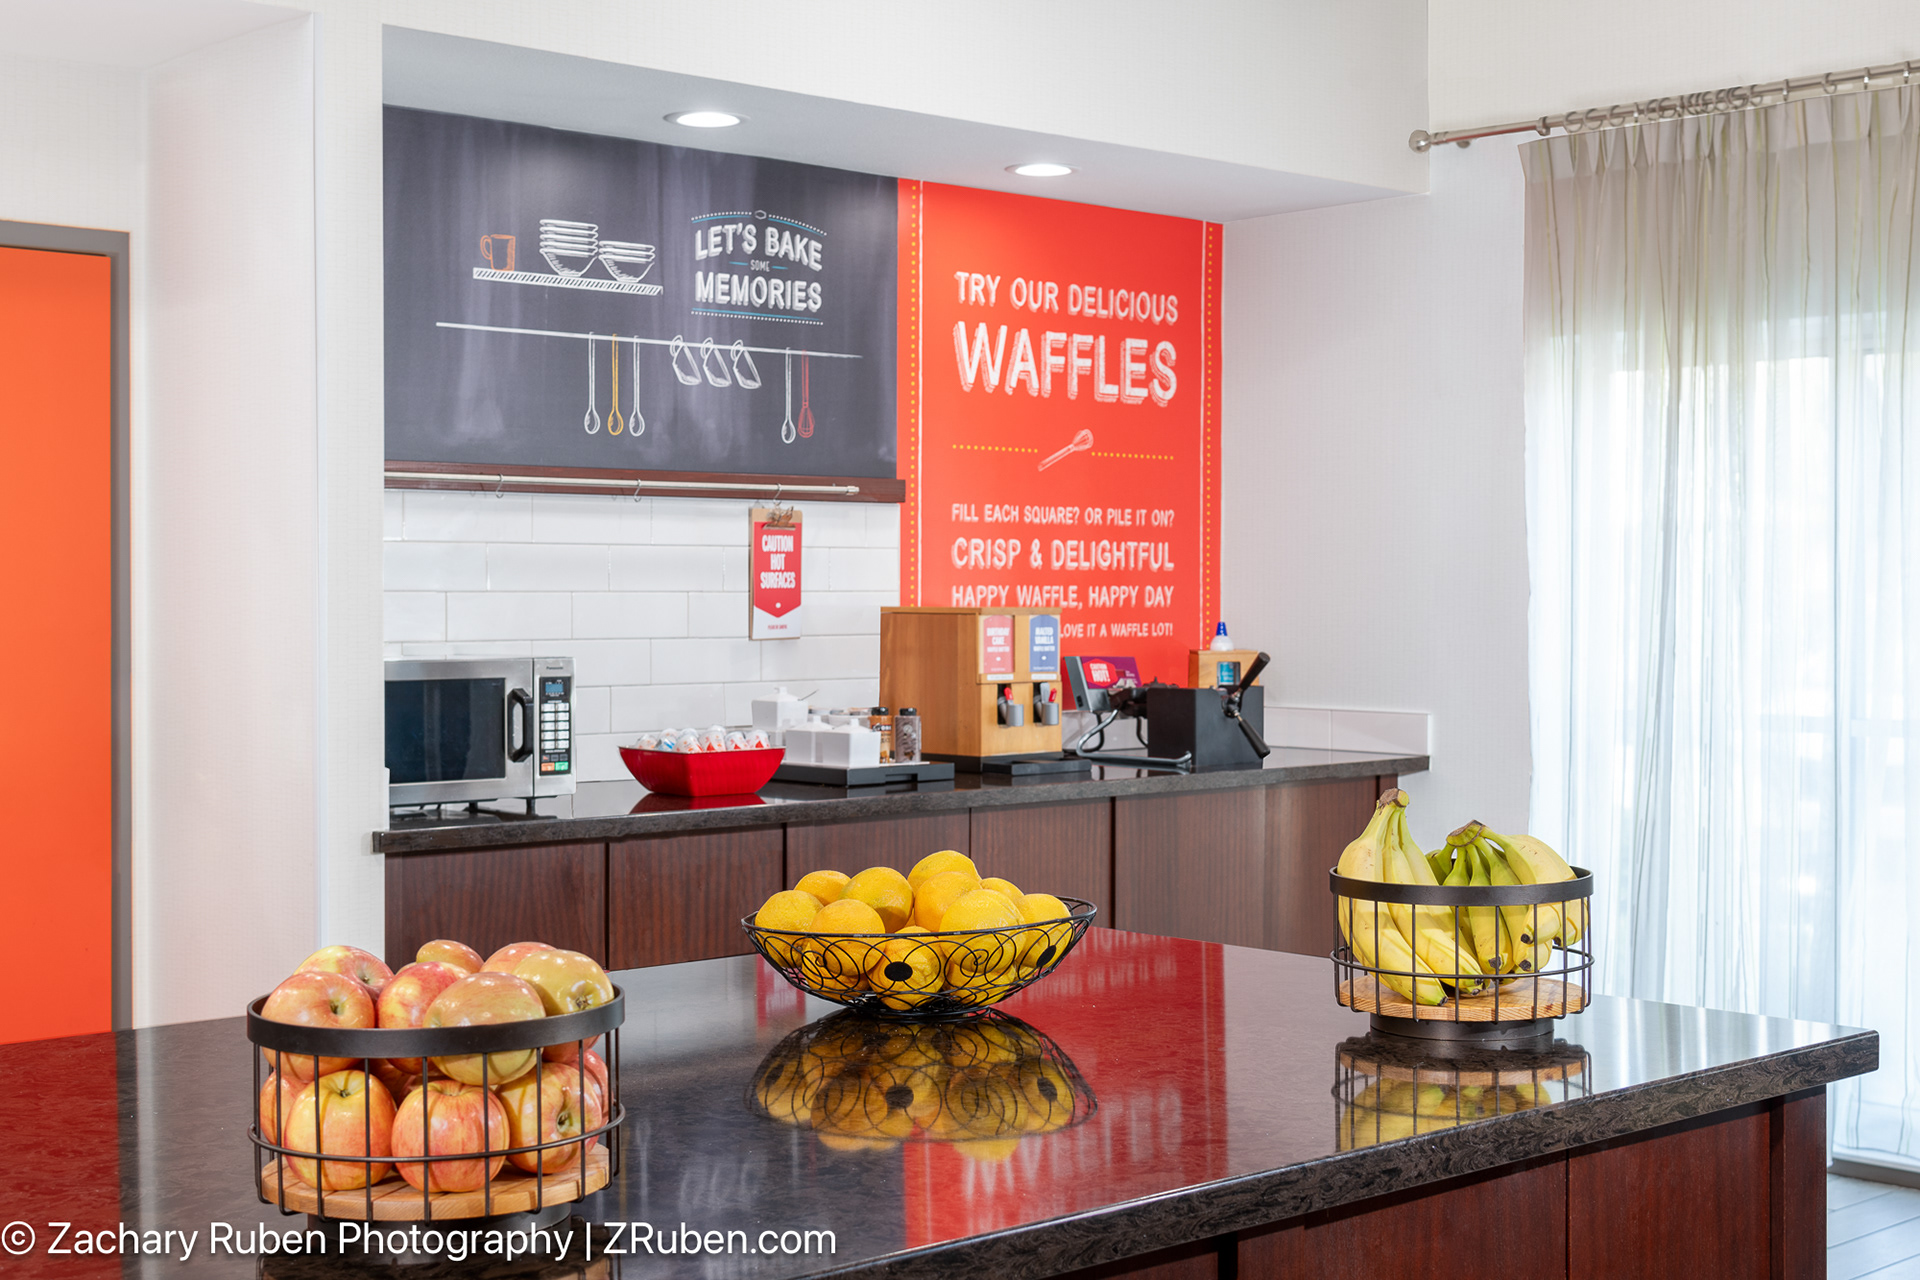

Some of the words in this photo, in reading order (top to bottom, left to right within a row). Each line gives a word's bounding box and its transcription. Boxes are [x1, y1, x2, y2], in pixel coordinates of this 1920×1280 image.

[695, 222, 757, 260] LET'S
[764, 226, 823, 272] BAKE
[750, 259, 770, 272] SOME
[694, 270, 823, 312] MEMORIES
[953, 270, 1001, 307] TRY
[1009, 277, 1060, 314] OUR
[1067, 283, 1178, 326] DELICIOUS
[952, 320, 1177, 408] WAFFLES
[951, 503, 979, 523] FILL
[984, 504, 1020, 523] EACH
[1023, 506, 1080, 525] SQUARE?
[1084, 507, 1102, 525] OR
[1106, 508, 1132, 526] PILE
[1136, 509, 1148, 526] IT
[1151, 509, 1175, 528] ON?
[762, 535, 794, 553] CAUTION
[951, 537, 1021, 570] CRISP
[1030, 538, 1043, 570] &
[1050, 539, 1175, 572] DELIGHTFUL
[770, 553, 786, 571] HOT
[760, 571, 796, 589] SURFACES
[951, 585, 1010, 608] HAPPY
[1016, 585, 1083, 611] WAFFLE,
[1088, 585, 1140, 609] HAPPY
[1144, 585, 1175, 608] DAY
[1086, 623, 1097, 638] IT
[1099, 623, 1107, 638] A
[1110, 622, 1149, 637] WAFFLE
[1151, 622, 1174, 637] LOT!
